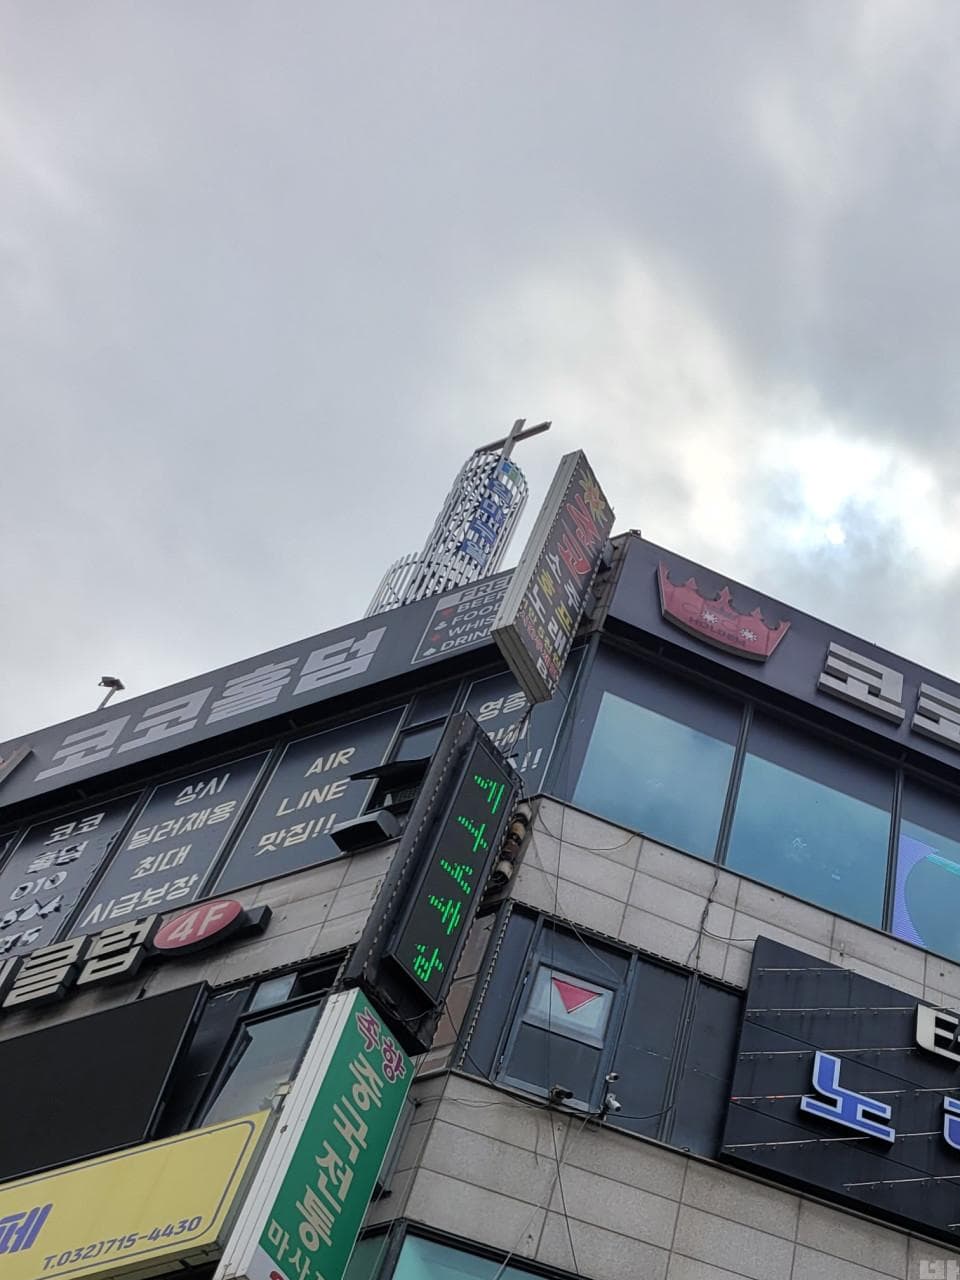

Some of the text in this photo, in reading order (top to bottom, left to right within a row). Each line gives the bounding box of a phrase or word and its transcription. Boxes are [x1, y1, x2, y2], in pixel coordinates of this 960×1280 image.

[460, 574, 513, 601] FRE
[440, 627, 491, 651] DRIN
[449, 614, 497, 637] WHIS
[34, 626, 389, 782] 코코홀덤
[304, 747, 356, 778] AIR
[174, 773, 231, 806] 상시
[276, 777, 351, 817] LINE
[43, 812, 106, 846] 코코
[127, 800, 238, 851] 딜러채용
[255, 813, 337, 857] 맛집!!
[129, 844, 193, 881] 최대
[80, 873, 200, 928] 시급보장
[0, 914, 158, 1004] 클럽
[167, 902, 232, 942] 4F
[295, 1052, 385, 1255] 중국전통
[42, 1214, 203, 1273] T.032)715-4430
